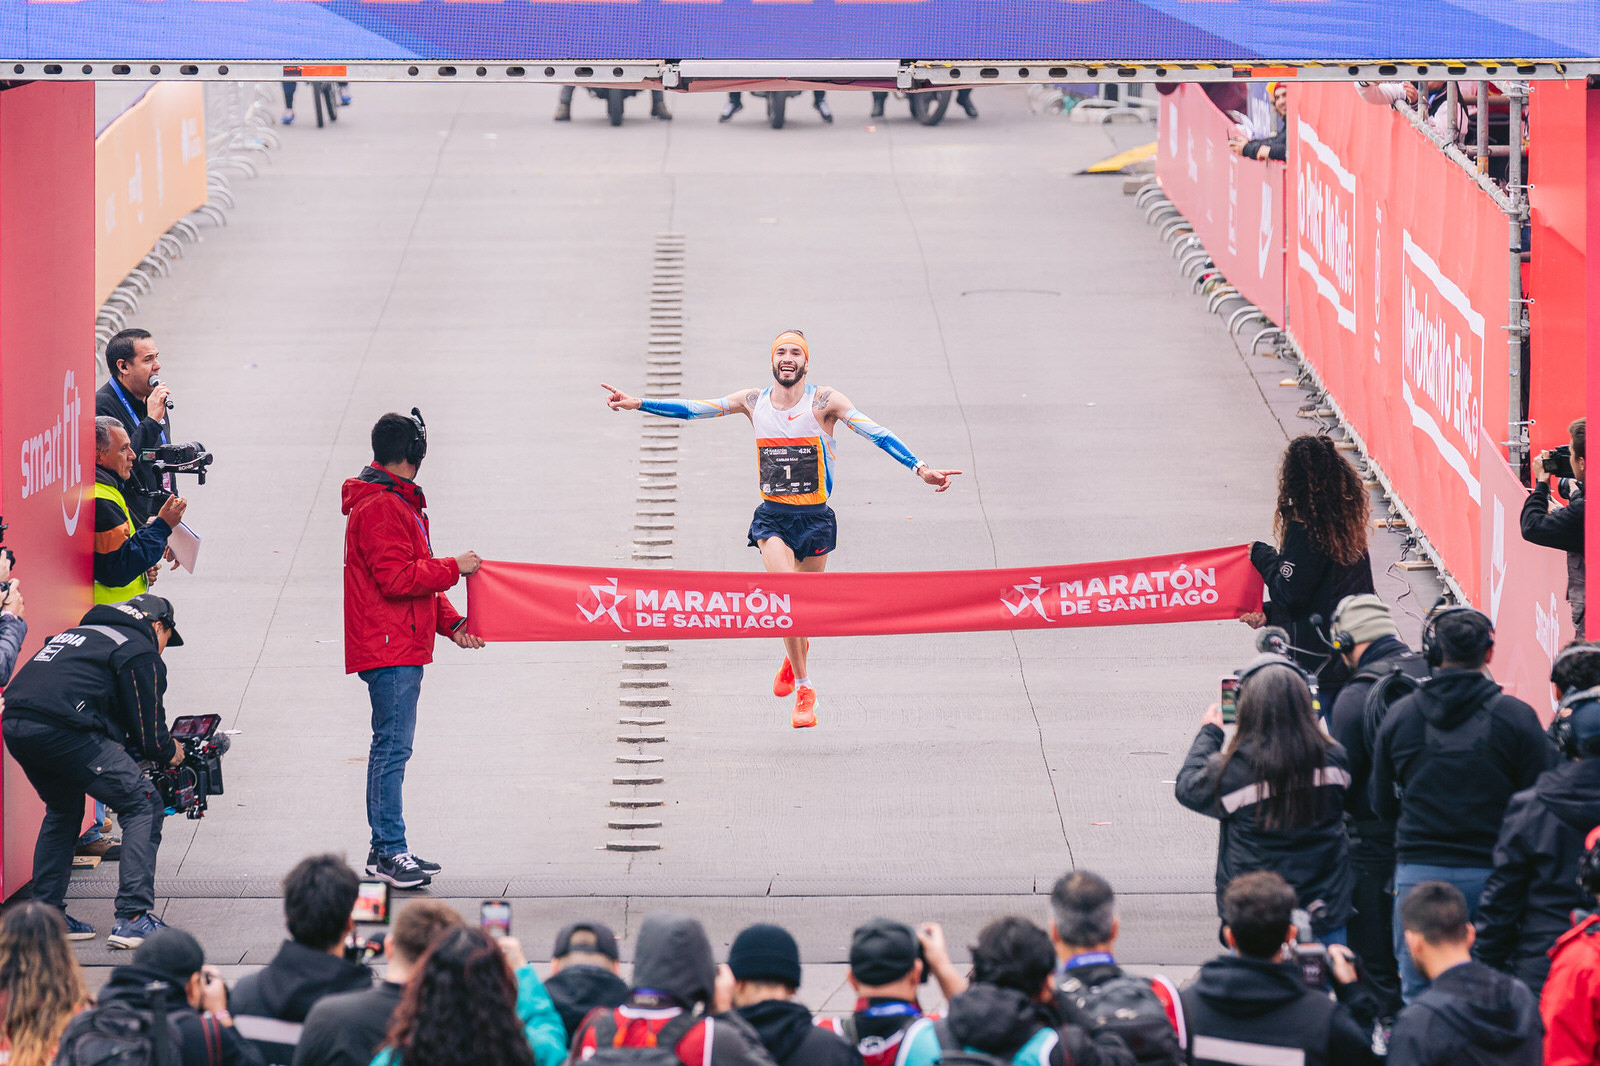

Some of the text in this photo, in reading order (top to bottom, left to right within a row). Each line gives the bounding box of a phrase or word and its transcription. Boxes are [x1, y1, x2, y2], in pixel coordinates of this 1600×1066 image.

[783, 465, 791, 480] 1
[1059, 564, 1216, 599] MARATÓN
[635, 588, 791, 614] MARATÓN
[1060, 588, 1219, 616] DE SANTIAGO
[636, 612, 794, 629] DE SANTIAGO
